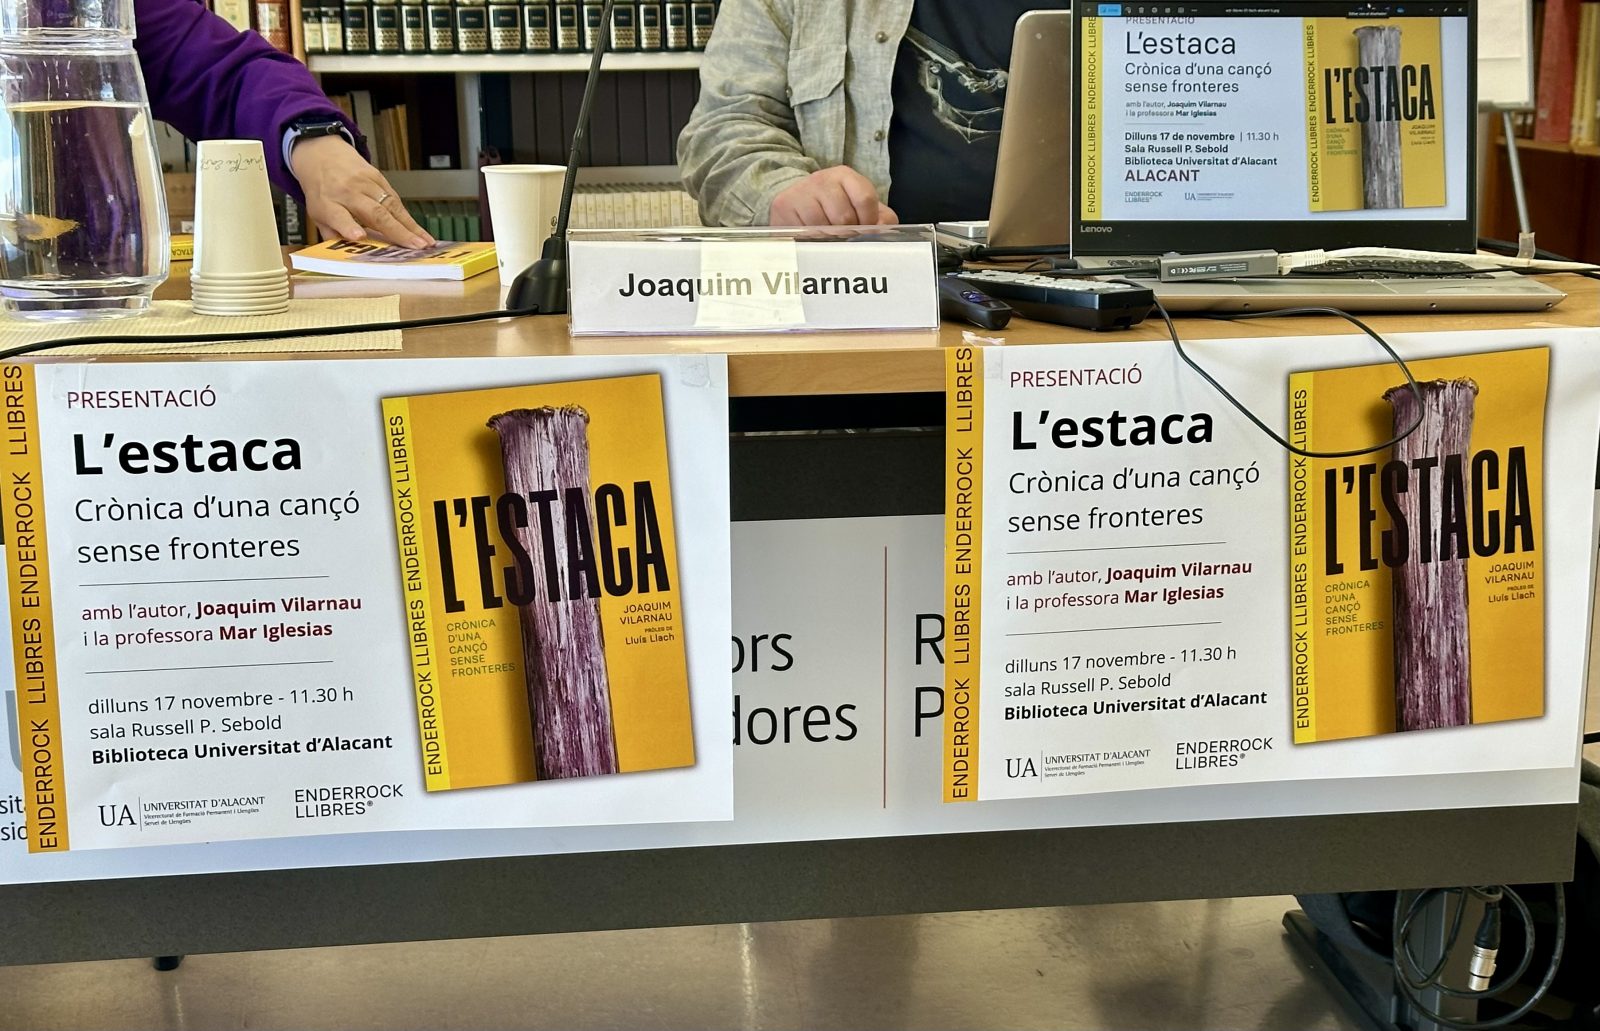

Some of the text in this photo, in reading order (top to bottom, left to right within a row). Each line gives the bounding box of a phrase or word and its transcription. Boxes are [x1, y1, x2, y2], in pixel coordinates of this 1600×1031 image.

[1126, 31, 1236, 55] L'estaca
[1088, 51, 1096, 109] ENDERROCK
[1125, 62, 1272, 78] Crònica d'una cançó
[1125, 80, 1239, 93] sense fronteres
[1324, 64, 1436, 124] L'ESTACA
[1167, 101, 1197, 109] Joaquim
[1190, 110, 1217, 118] Iglesias
[1306, 24, 1319, 203] ENDERROCK LLIBRES ENDERROCK LLIBRES
[1088, 114, 1096, 151] LLIBRES
[1125, 132, 1271, 141] Dilluns 17 de novembre 11.30
[1125, 145, 1228, 153] Sala Russell P. Sebold
[1125, 157, 1277, 166] Biblioteca Universitat d'Alacant
[1088, 154, 1096, 213] ENDERROCK
[1125, 170, 1200, 182] ALACANT
[1080, 225, 1113, 233] Lenovo
[619, 271, 889, 302] Joaquim Vilarnau
[1010, 363, 1143, 388] PRESENTACIÓ
[67, 385, 217, 409] PRESENTACIÓ
[1012, 410, 1213, 450] L'estaca
[73, 432, 303, 476] L'estaca
[1009, 461, 1260, 494] Crònica d'una cançó
[75, 490, 360, 522] Crònica d'una cançó
[1294, 457, 1308, 556] ENDERROCK
[1324, 446, 1535, 576] L'ESTACA
[1008, 506, 1204, 533] sense fronteres
[77, 536, 301, 563] sense fronteres
[432, 480, 671, 614] L'ESTACA
[953, 348, 973, 798] ENDERROCK LLIBRES ENDERROCK LLIBRES
[1006, 561, 1253, 587] amb l'autor, Joaquim Vilarnau
[1484, 571, 1535, 584] VILARNAU
[1488, 560, 1535, 573] JOAQUIM
[388, 414, 443, 776] ENDERROCK LLIBRES ENDERROCK LLIBRES
[1294, 562, 1308, 627] LLIBRES
[1325, 580, 1371, 593] CRÒNICA
[1325, 592, 1356, 604] D'UNA
[1511, 591, 1535, 601] Llach
[4, 365, 58, 848] ENDERROCK LLIBRES ENDERROCK LLIBRES
[81, 596, 363, 622] amb l'autor, Joaquim Vilarnau
[623, 601, 672, 614] JOAQUIM
[1015, 585, 1225, 613] la professora Mar Iglesias
[1325, 601, 1361, 615] CANÇÓ
[446, 618, 497, 632] CRÒNICA
[619, 612, 673, 625] VILARNAU
[1325, 613, 1358, 626] SENSE
[1325, 621, 1385, 636] FRONTERES
[93, 622, 334, 649] la professora Mar Iglesias
[447, 630, 482, 644] D'UNA
[650, 632, 675, 643] Llach
[448, 641, 488, 656] CANÇÓ
[450, 654, 486, 667] SENSE
[1004, 646, 1237, 674] dilluns 17 novembre 11.30 h
[451, 662, 516, 678] FRONTERES
[1295, 630, 1310, 729] ENDERROCK
[1004, 673, 1172, 698] sala Russell P. Sebold
[88, 687, 354, 715] dilluns 17 novembre 11.30 h
[1004, 691, 1268, 721] Biblioteca Universitat d'Alacant
[89, 715, 283, 740] sala Russell P. Sebold
[92, 733, 394, 765] Biblioteca Universitat d'Alacant
[1045, 749, 1151, 765] UNIVERSITAT D'ALACANT
[1176, 737, 1274, 755] ENDERROCK
[1005, 757, 1039, 779] UA
[143, 796, 266, 812] UNIVERSITAT D'ALACANT
[294, 783, 404, 803] ENDERROCK
[97, 804, 138, 827] UA
